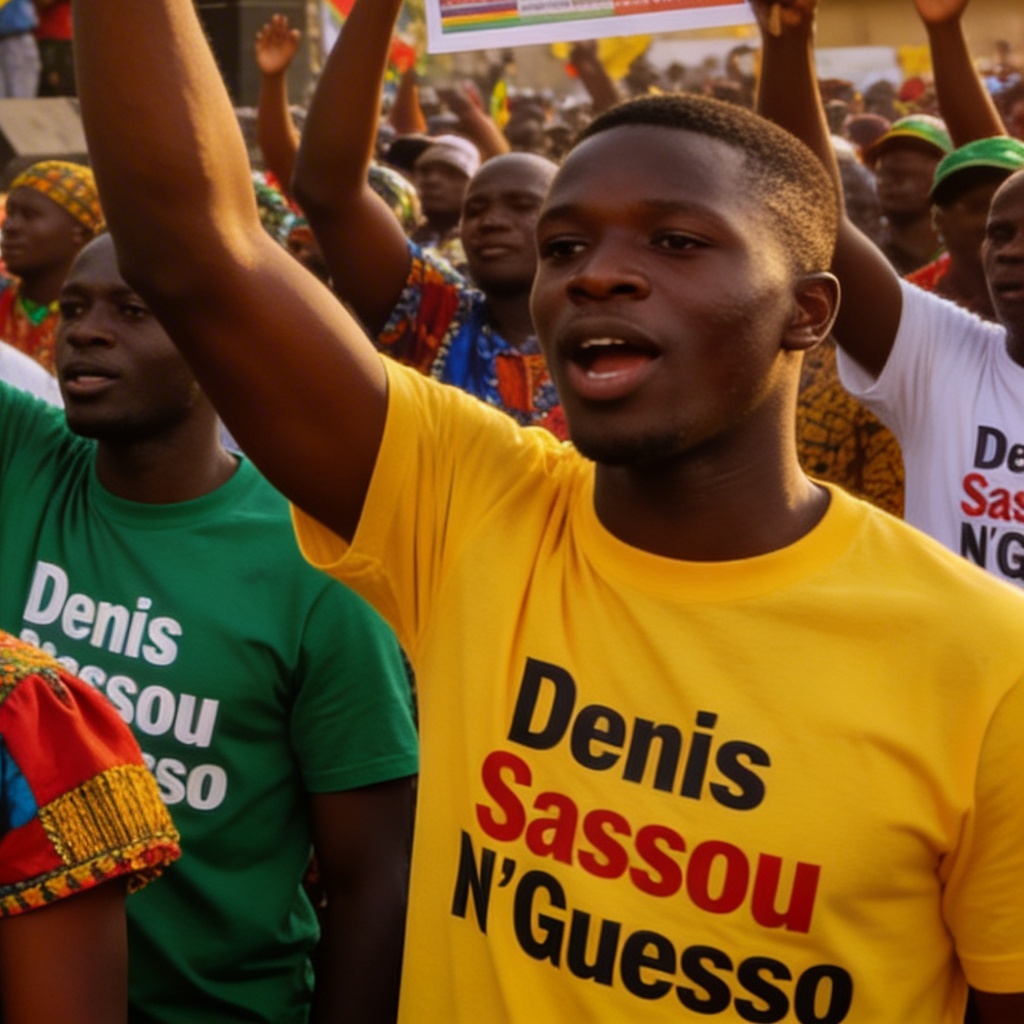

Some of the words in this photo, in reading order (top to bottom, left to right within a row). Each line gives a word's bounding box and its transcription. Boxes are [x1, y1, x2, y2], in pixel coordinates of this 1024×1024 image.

[23, 560, 183, 666] Denis
[507, 656, 771, 811] Denis
[451, 829, 854, 1024] N'Guesso
[476, 750, 821, 934] Sassou
